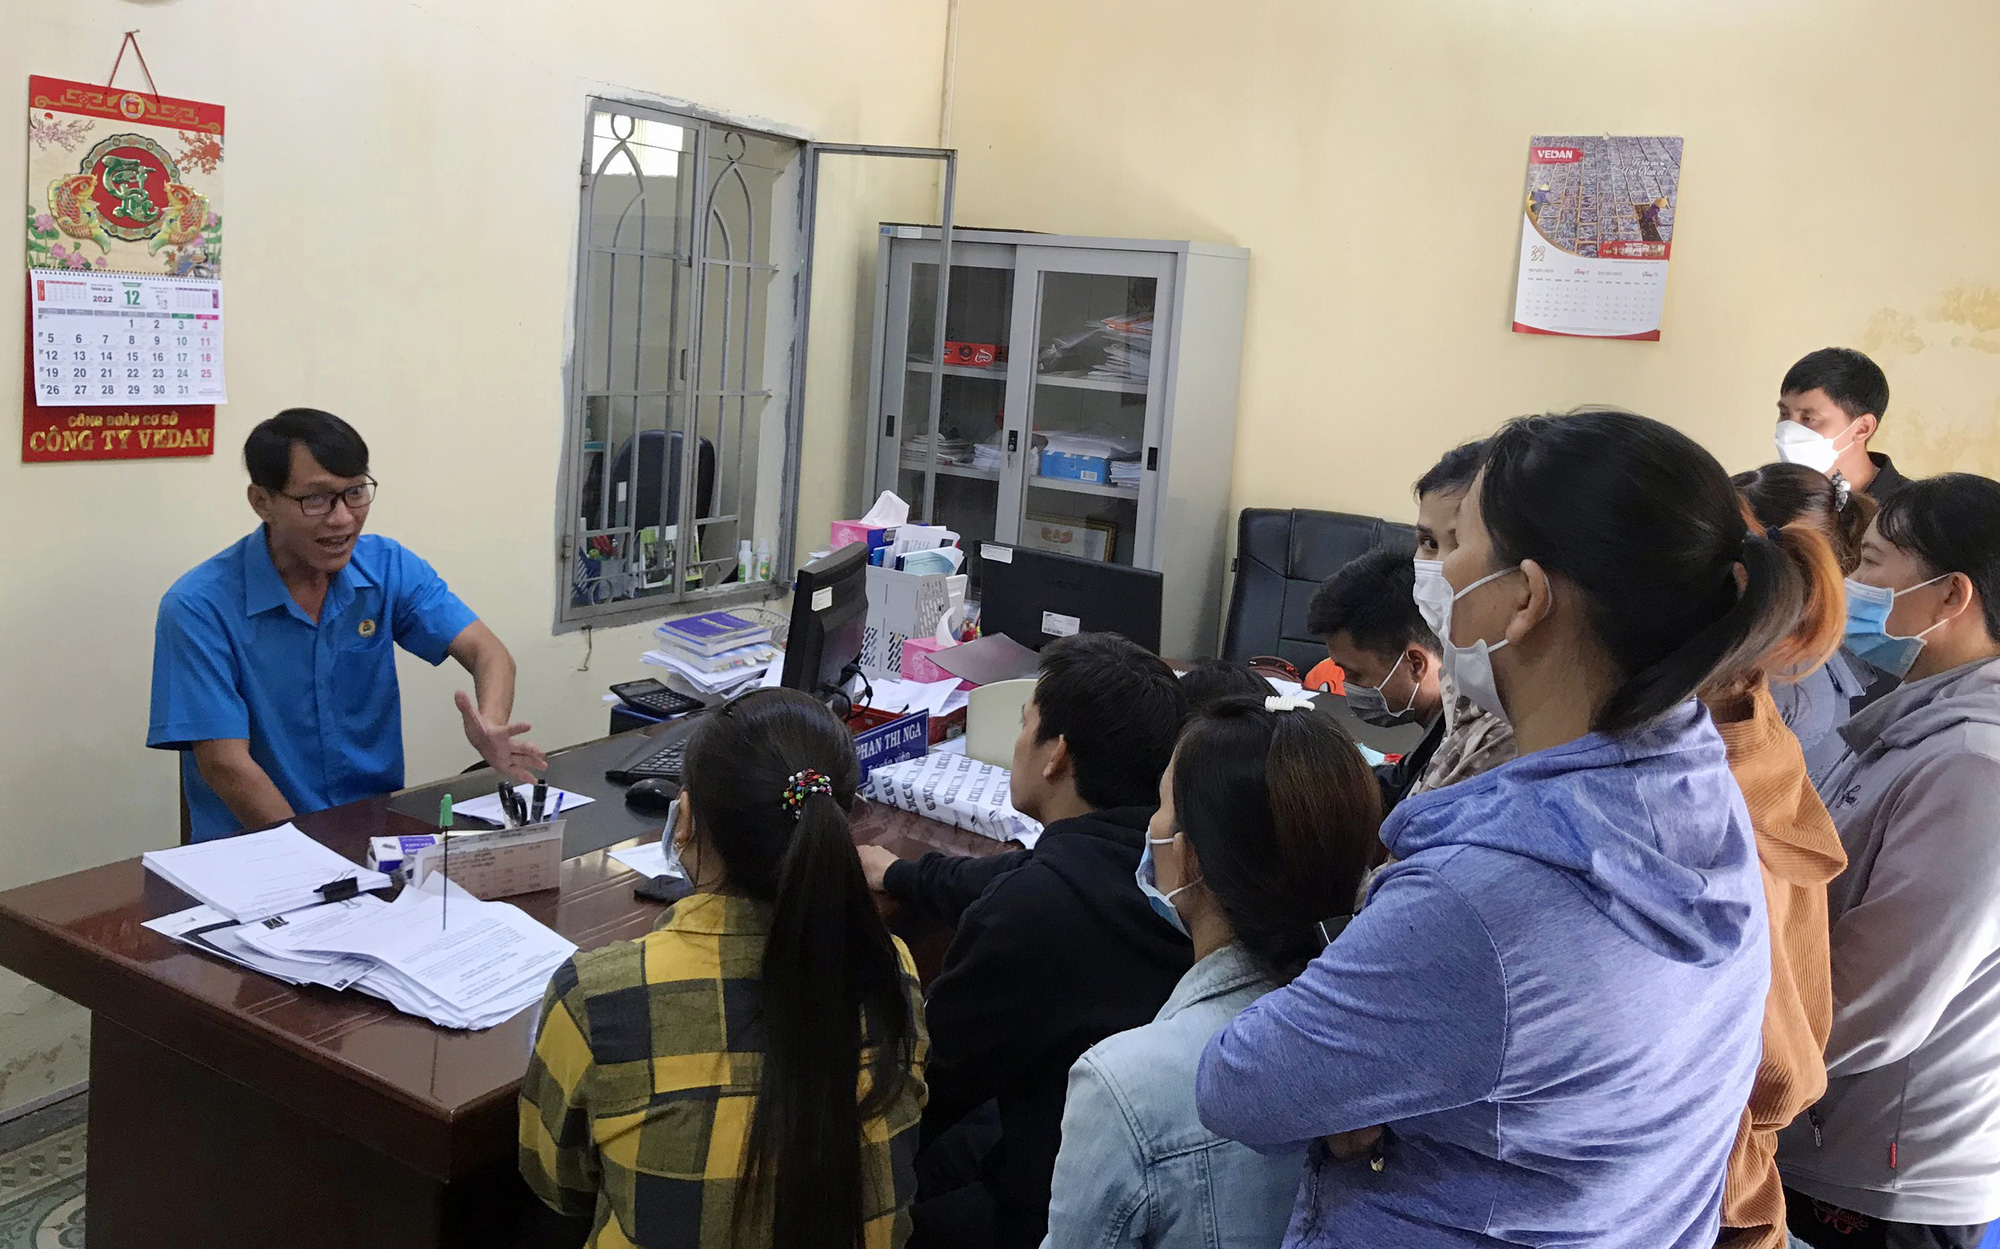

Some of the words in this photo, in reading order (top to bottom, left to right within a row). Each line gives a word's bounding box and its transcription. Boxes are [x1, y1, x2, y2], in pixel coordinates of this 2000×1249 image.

[1537, 149, 1573, 159] VEDAN
[92, 295, 113, 303] 2022
[123, 289, 141, 306] 12
[129, 319, 134, 328] 1
[154, 320, 160, 329] 2
[178, 320, 184, 330] 3
[202, 322, 208, 330] 4
[48, 333, 54, 343] 5
[75, 334, 82, 343] 6
[102, 334, 109, 344] 7
[129, 335, 135, 345] 8
[154, 336, 160, 345] 9
[176, 336, 187, 346] 10
[200, 338, 210, 346] 11
[45, 350, 58, 360] 12
[74, 351, 86, 361] 13
[101, 352, 112, 361] 14
[127, 352, 139, 361] 15
[152, 352, 164, 362] 16
[177, 353, 188, 362] 17
[200, 353, 211, 362] 18
[46, 367, 59, 378] 19
[73, 368, 87, 378] 20
[100, 368, 112, 378] 21
[127, 368, 139, 378] 22
[152, 369, 164, 378] 23
[177, 369, 188, 378] 24
[201, 369, 212, 378] 25
[46, 385, 60, 395] 26
[74, 385, 87, 395] 27
[101, 385, 114, 395] 28
[128, 385, 140, 395] 29
[153, 385, 165, 395] 30
[178, 385, 189, 394] 31
[67, 413, 103, 427] CÔNG
[142, 413, 160, 426] CƠ
[29, 425, 94, 452] CÔNG
[101, 429, 132, 450] TY
[137, 428, 211, 450] VEDAN
[855, 737, 882, 760] PHAN
[884, 729, 901, 749] THỊ
[903, 722, 922, 743] NGA
